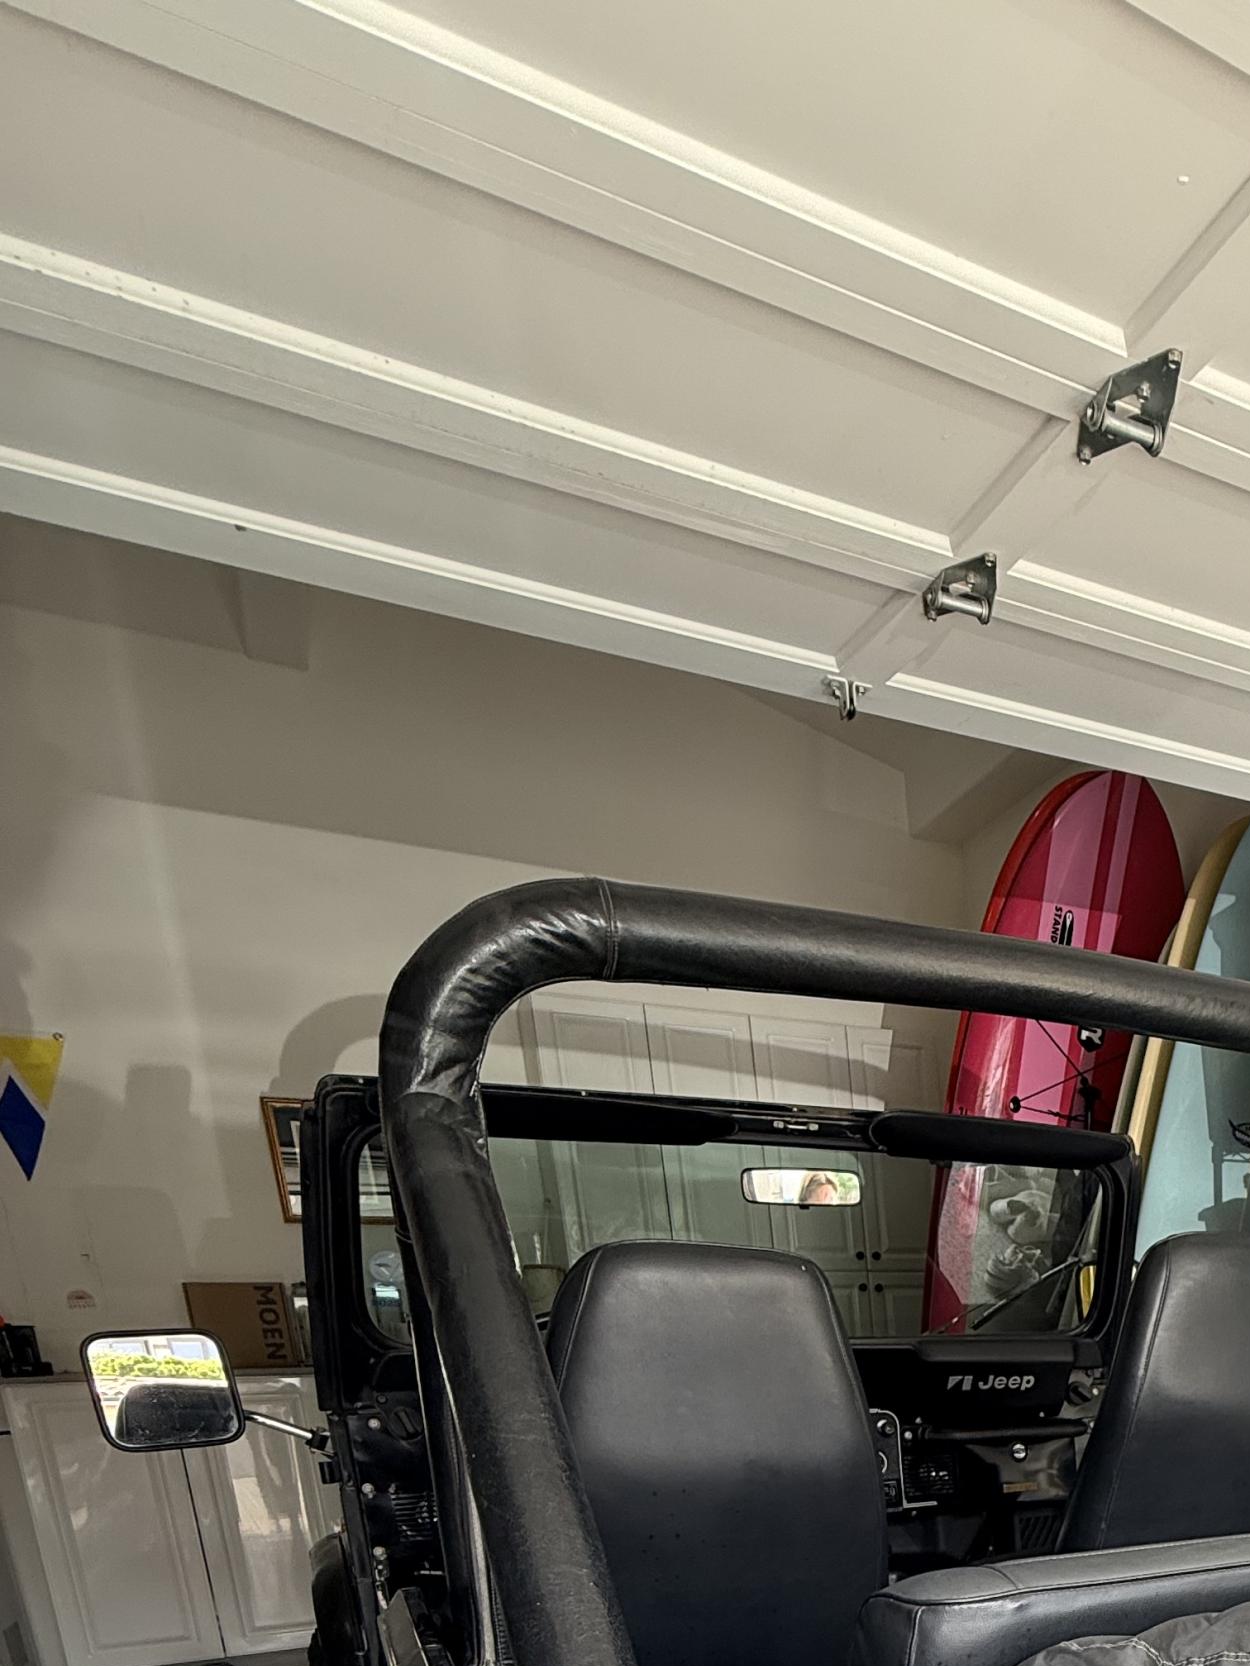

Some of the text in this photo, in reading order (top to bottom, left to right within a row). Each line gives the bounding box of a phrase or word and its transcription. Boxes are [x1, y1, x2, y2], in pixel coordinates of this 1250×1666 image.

[1050, 905, 1063, 944] STAND
[253, 1285, 288, 1360] MOEN
[978, 1374, 1035, 1391] Jeep
